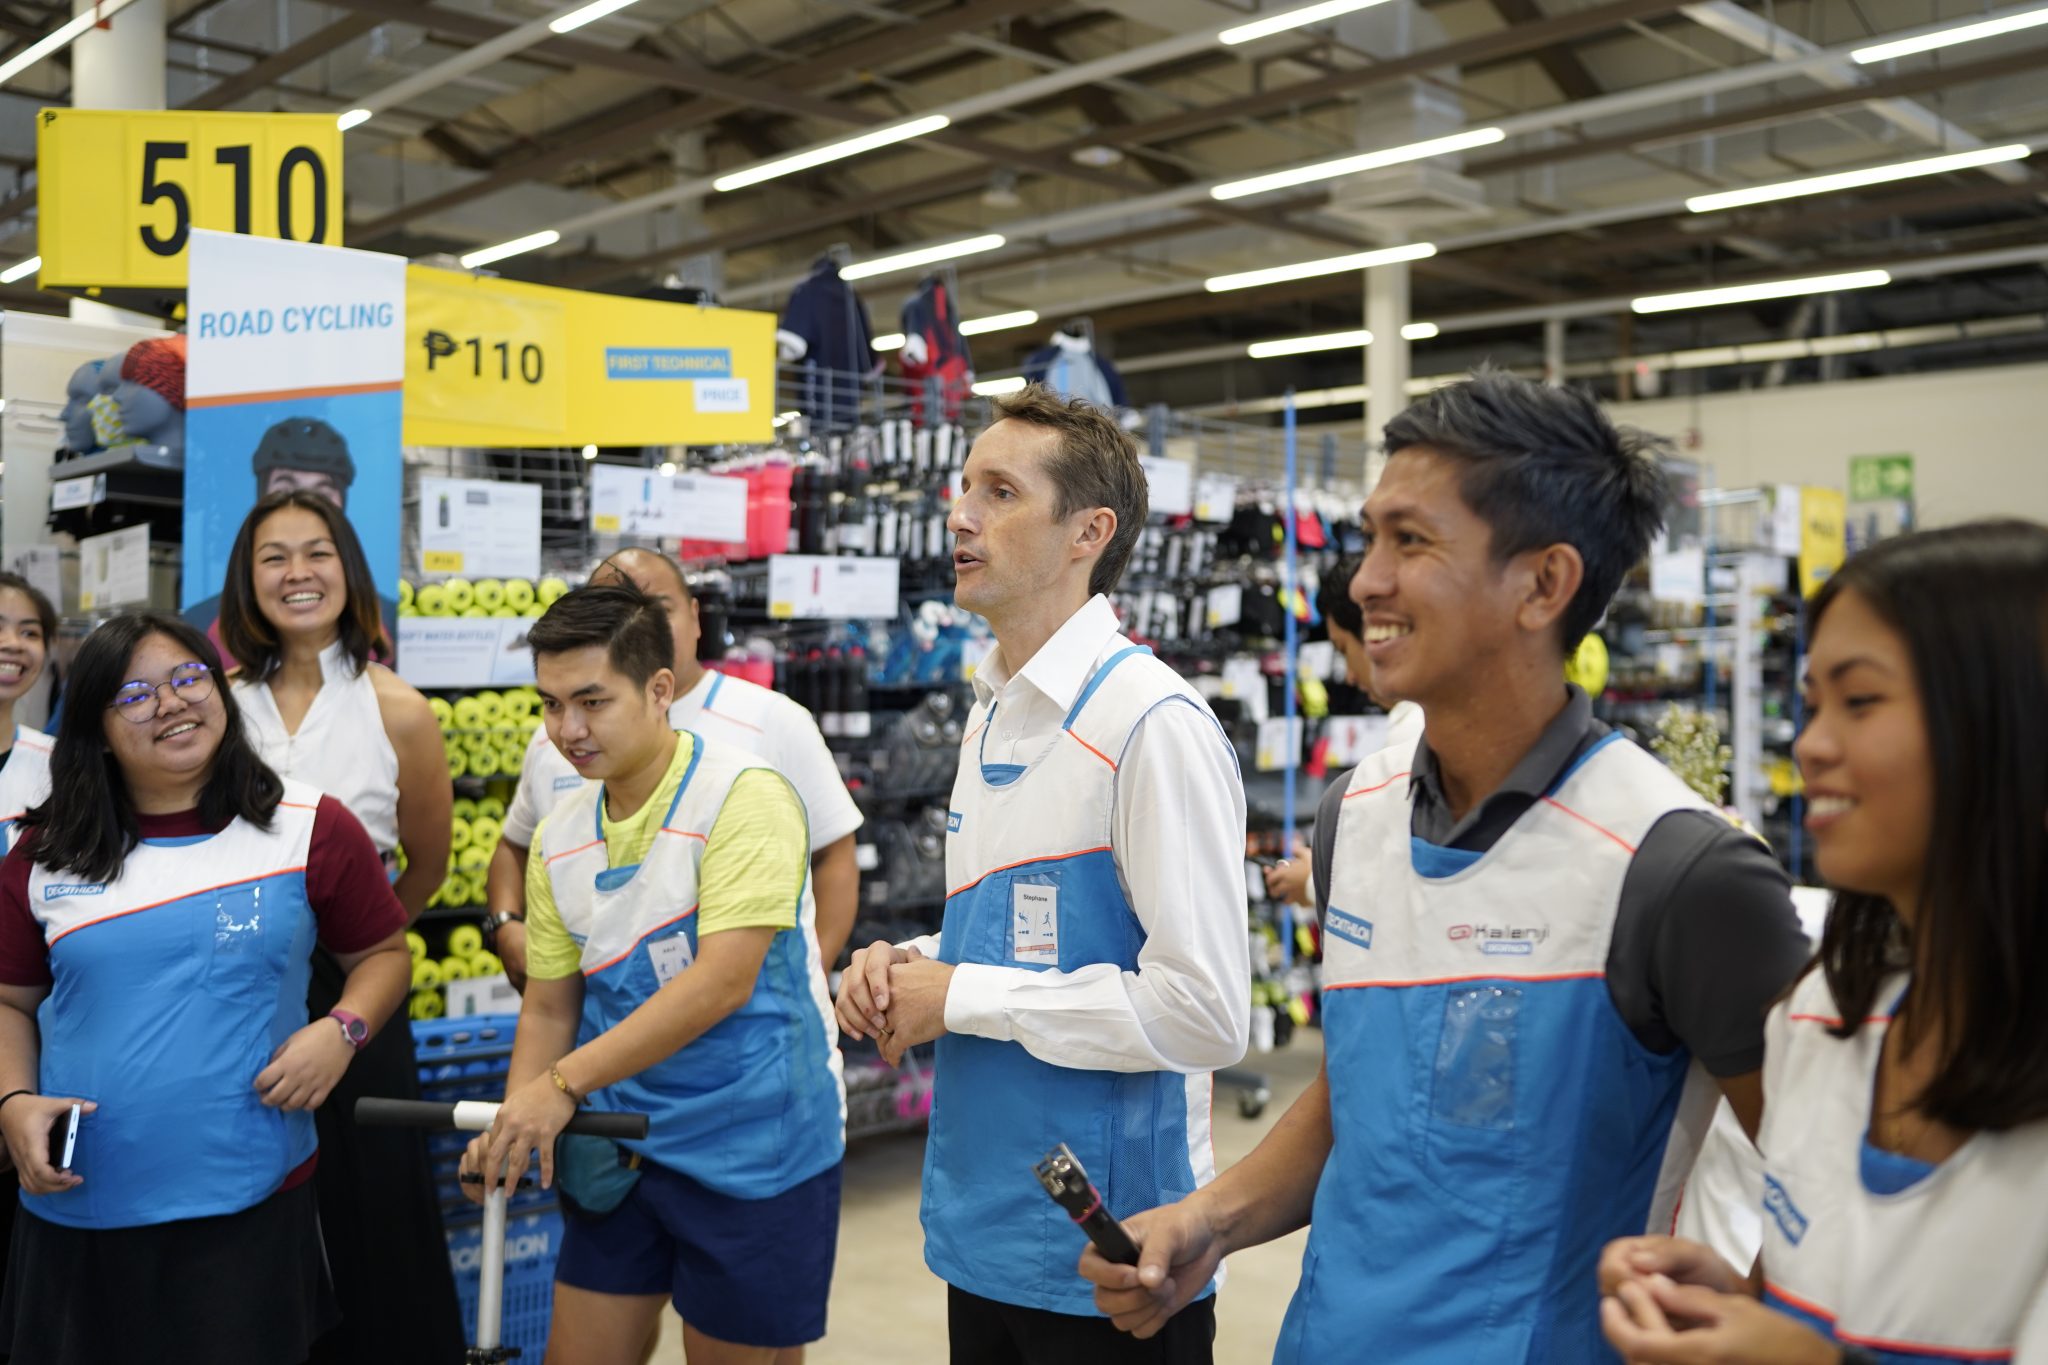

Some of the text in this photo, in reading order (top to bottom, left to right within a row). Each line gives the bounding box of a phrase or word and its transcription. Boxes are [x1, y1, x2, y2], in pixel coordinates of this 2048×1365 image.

[139, 141, 328, 257] 510
[200, 302, 393, 339] ROAD CYCLING
[609, 355, 728, 371] FIRST TECHNICAL
[702, 388, 741, 401] PRICE
[47, 885, 103, 899] DECATHLON
